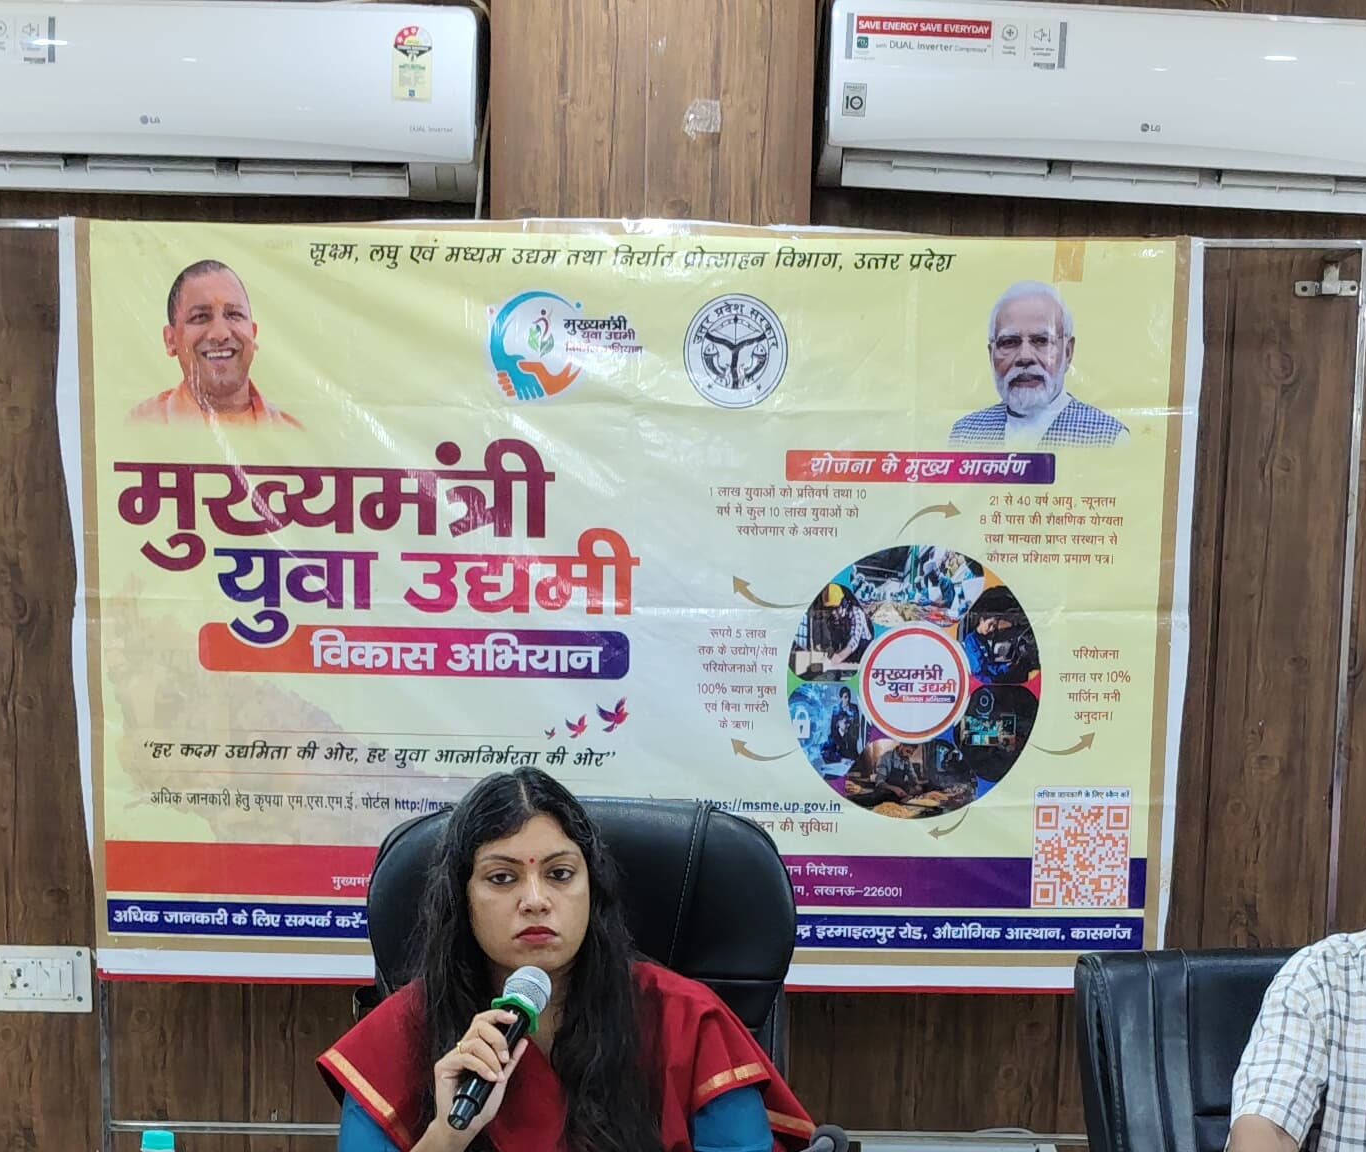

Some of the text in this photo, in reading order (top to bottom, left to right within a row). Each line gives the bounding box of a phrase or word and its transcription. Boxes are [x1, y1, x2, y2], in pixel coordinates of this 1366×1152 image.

[858, 20, 989, 35] SAVE ENERGY SAVE EVERYDAY
[889, 40, 914, 49] DUAL
[917, 41, 953, 52] Inverter
[309, 238, 957, 273] सूक्ष्म, लघु एवं मध्यम उद्यम तथा निर्यात प्रोत्साहन विभाग, उत्तर प्रदेश
[563, 315, 628, 336] मुख्यमंत्री
[581, 328, 636, 343] युवा उद्यमी
[810, 452, 1031, 482] योजना के मुख्य आकर्षण
[717, 487, 740, 497] लाख
[744, 485, 776, 501] युवाओं
[779, 485, 793, 498] को
[796, 485, 829, 499] प्रतिवर्ष
[833, 488, 852, 499] तथा
[856, 489, 867, 499] 10
[989, 496, 999, 506] 21
[1003, 492, 1013, 506] से
[1017, 496, 1031, 506] 40
[1035, 493, 1049, 507] वर्ष
[1081, 496, 1116, 510] न्यूनतम
[114, 438, 556, 571] मुख्यमंत्री
[716, 503, 730, 517] वर्ष
[747, 506, 765, 520] कुल
[770, 506, 780, 517] 10
[785, 507, 807, 518] लाख
[811, 504, 842, 521] युवाओं
[846, 505, 859, 518] को
[979, 515, 987, 525] 8
[1006, 515, 1025, 525] पास
[1029, 512, 1042, 525] की
[1090, 513, 1124, 527] योग्यता
[736, 523, 785, 537] स्वरोजगार
[789, 523, 799, 537] के
[985, 534, 1003, 544] तथा
[1008, 534, 1041, 545] मान्यता
[1045, 534, 1067, 545] प्राप्त
[1109, 531, 1118, 545] से
[213, 527, 641, 644] युवा उद्यमी
[735, 629, 742, 638] 5
[745, 629, 767, 639] लाख
[310, 629, 603, 674] विकास अभियान
[698, 645, 714, 656] तक
[718, 643, 727, 656] के
[1072, 646, 1120, 660] परियोजना
[761, 663, 773, 673] पर
[871, 664, 943, 687] मुख्यमंत्री
[1059, 670, 1131, 684] लागत पर 10%
[698, 682, 727, 695] 100%
[887, 678, 957, 698] युवा उद्यमी
[1102, 688, 1121, 703] मनी
[718, 717, 728, 729] के
[180, 743, 220, 758] कदम
[225, 739, 290, 760] उद्यमिता
[297, 740, 319, 761] की
[324, 742, 358, 764] ओर,
[366, 747, 389, 763] हर
[394, 748, 430, 769] युवा
[434, 744, 541, 766] आत्मनिर्भरता
[546, 745, 569, 766] की
[150, 787, 182, 804] अधिक
[186, 788, 231, 806] जानकारी
[235, 790, 251, 811] हेतु
[254, 793, 283, 812] कृपया
[361, 791, 390, 810] पोर्टल
[779, 817, 794, 832] की
[799, 818, 839, 836] सुविधा।
[806, 862, 853, 878] निदेशक,
[113, 905, 159, 923] अधिक
[163, 908, 229, 926] जानकारी
[232, 909, 248, 925] के
[252, 909, 280, 927] लिए
[285, 910, 332, 928] सम्पर्क
[815, 922, 1133, 944] इस्माइलपुर रोड, औद्योगिक आस्थान, कासगंज
